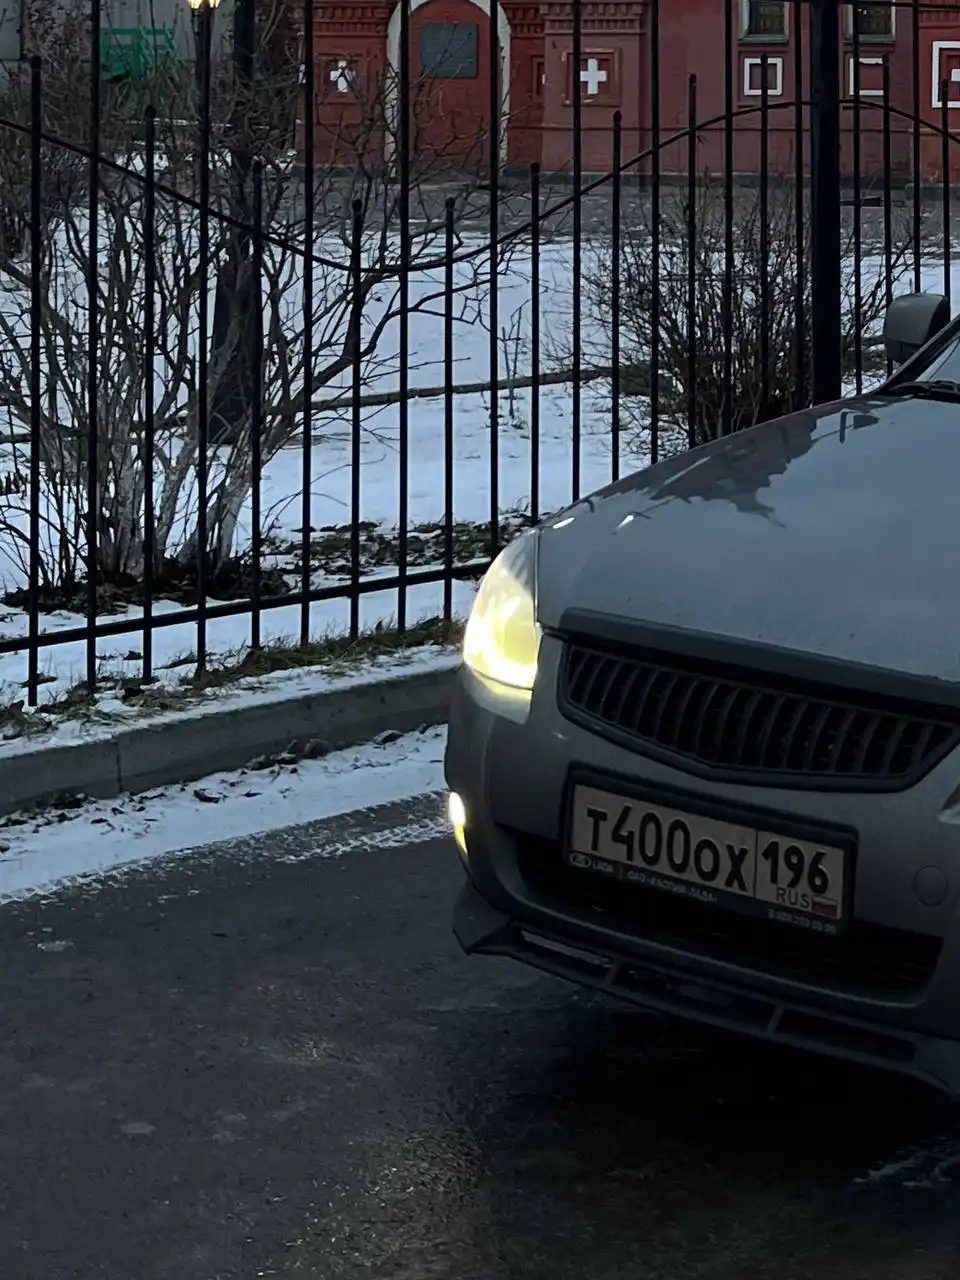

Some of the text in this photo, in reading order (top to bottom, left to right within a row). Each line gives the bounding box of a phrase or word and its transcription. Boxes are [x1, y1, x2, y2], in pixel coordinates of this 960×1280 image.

[587, 805, 829, 896] Т400ОХ 196
[776, 887, 811, 909] RUS
